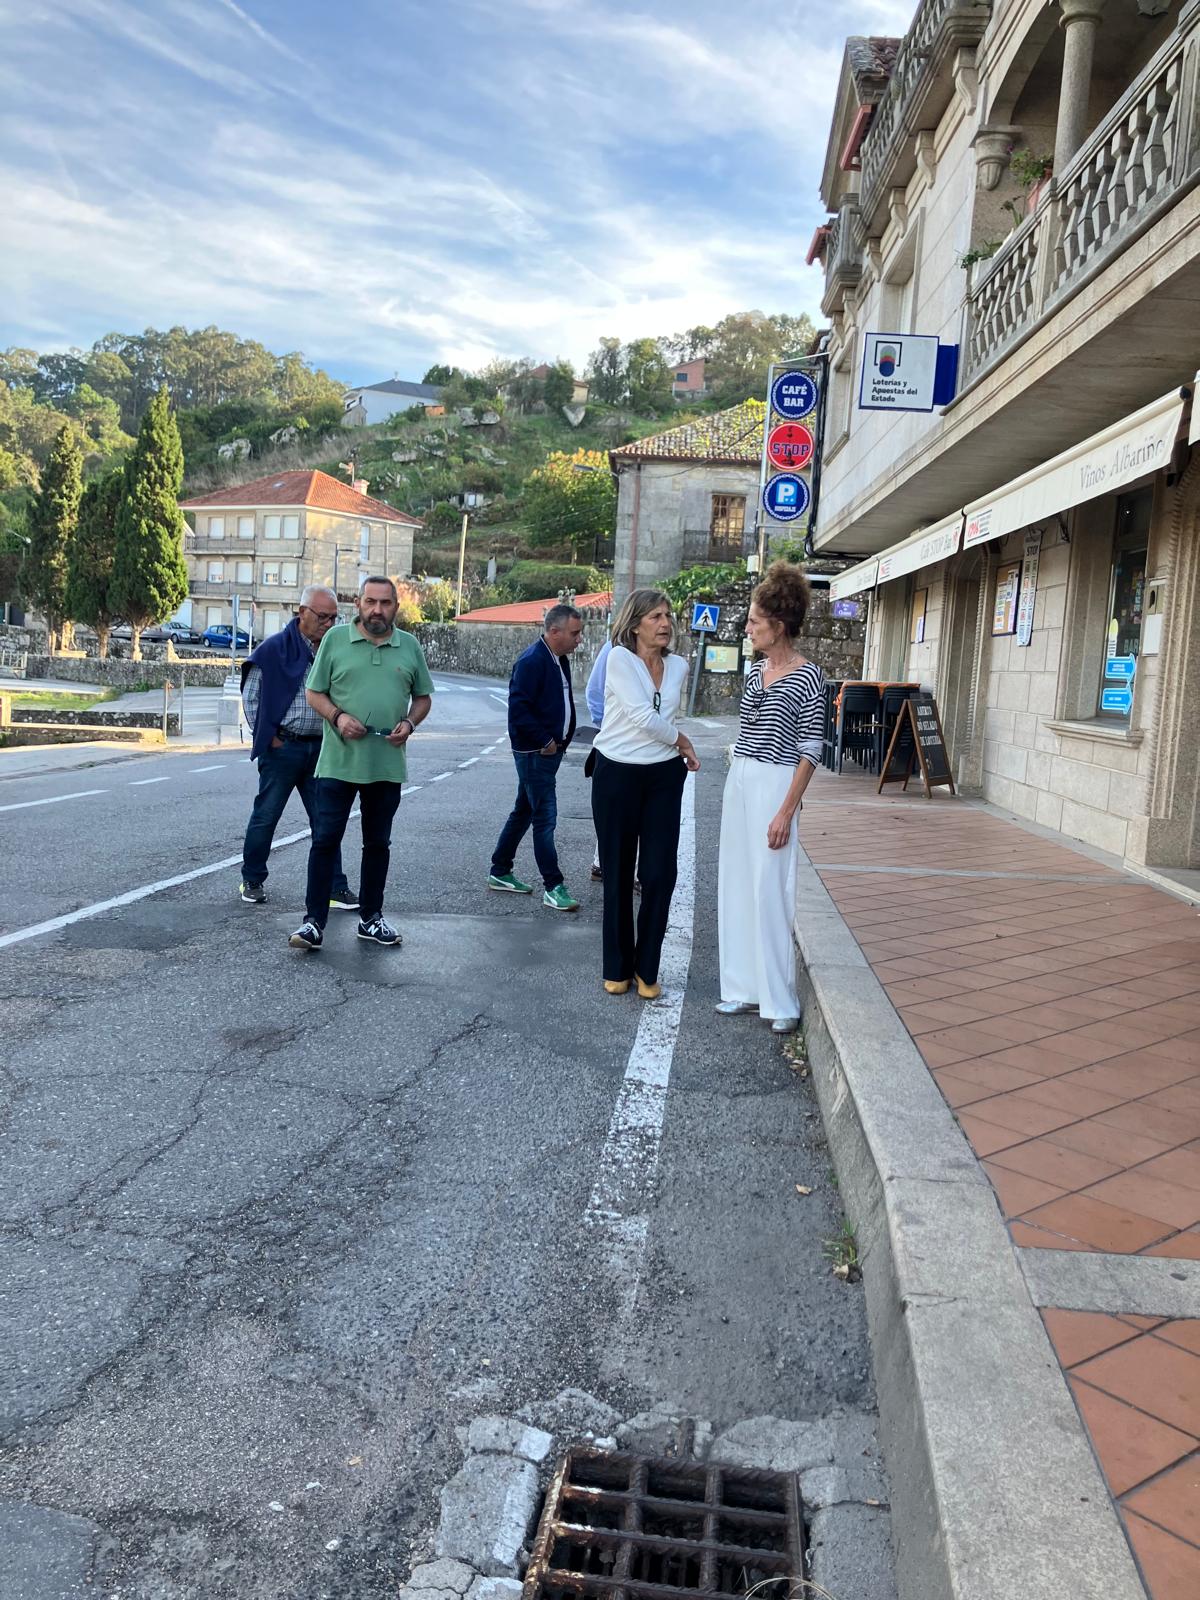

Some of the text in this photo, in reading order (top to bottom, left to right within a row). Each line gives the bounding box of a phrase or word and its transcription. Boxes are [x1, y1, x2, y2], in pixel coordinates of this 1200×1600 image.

[782, 384, 807, 395] CAFÉ
[872, 386, 905, 395] Apuestas
[783, 397, 804, 407] BAR
[772, 443, 809, 456] STOP
[1080, 464, 1106, 490] Vinos
[777, 482, 795, 503] P
[1123, 638, 1139, 654] BAR
